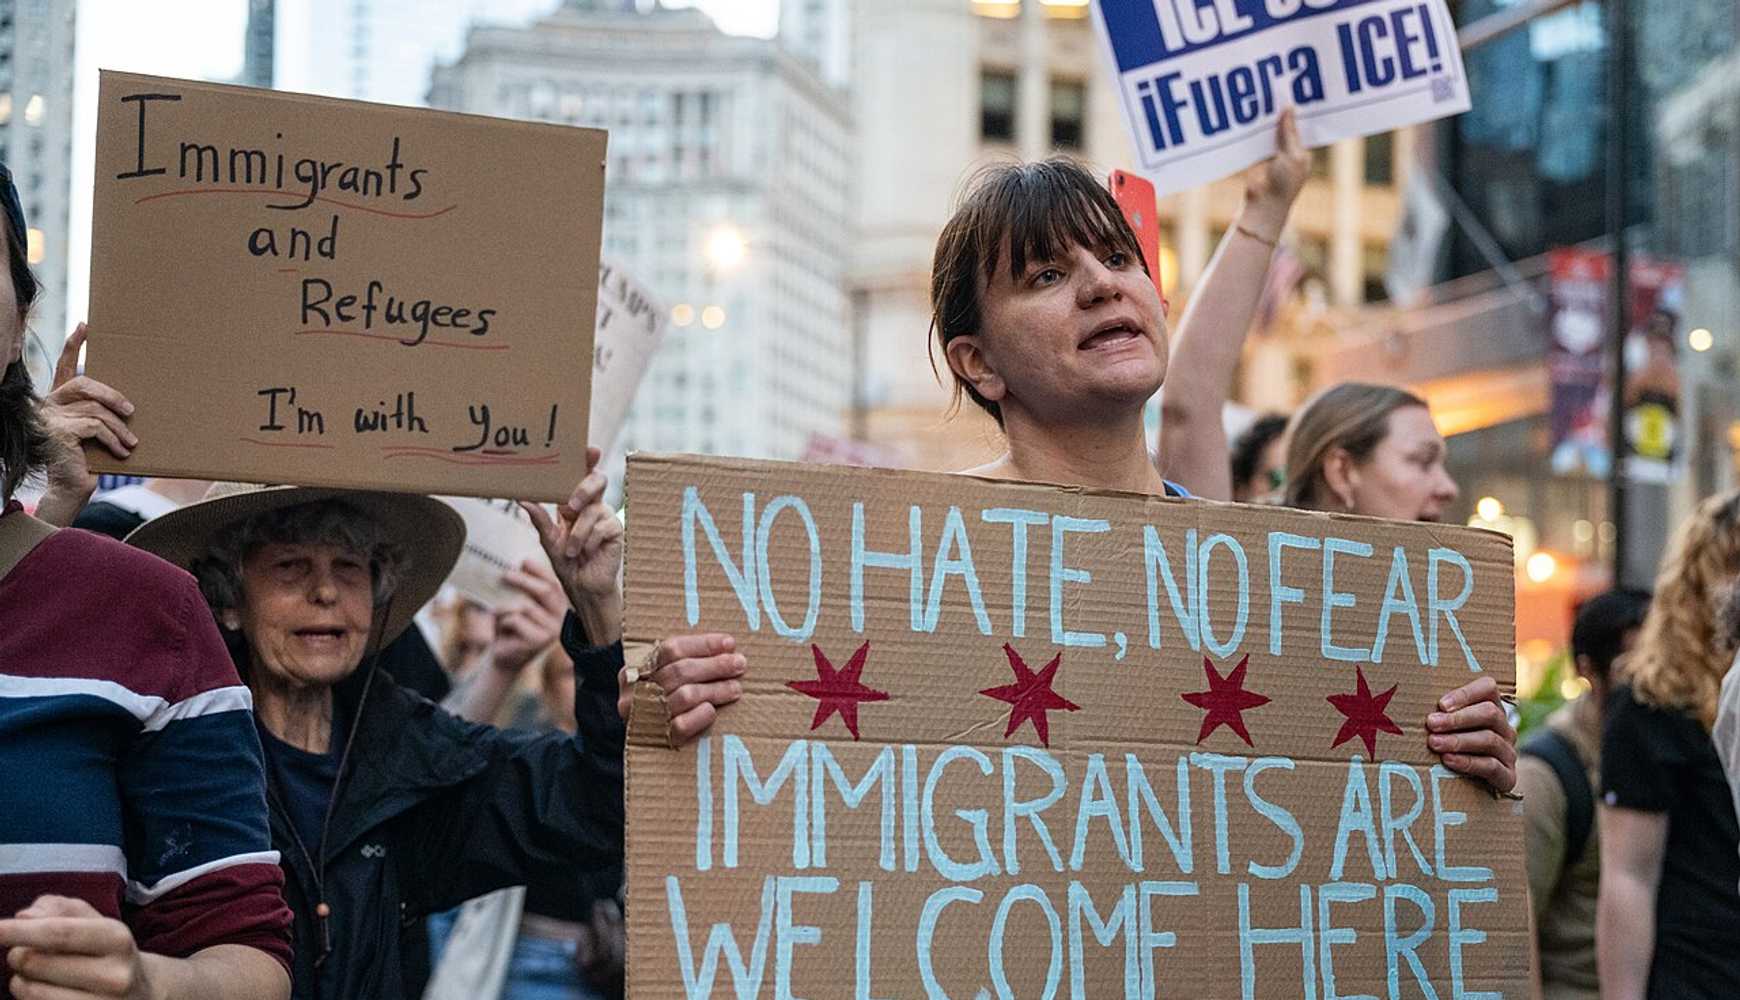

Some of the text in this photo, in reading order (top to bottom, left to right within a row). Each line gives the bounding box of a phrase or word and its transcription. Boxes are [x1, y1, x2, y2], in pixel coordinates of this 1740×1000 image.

[1337, 3, 1443, 94] ICE!
[117, 93, 428, 210] Immigrants
[247, 215, 338, 260] and
[301, 278, 496, 346] Refugees
[258, 387, 324, 434] I'm
[354, 392, 429, 434] with
[682, 486, 1483, 672] NO HATE, NO FEAR
[696, 734, 1495, 882] IMMIGRANTS ARE
[1237, 881, 1503, 1000] HERE
